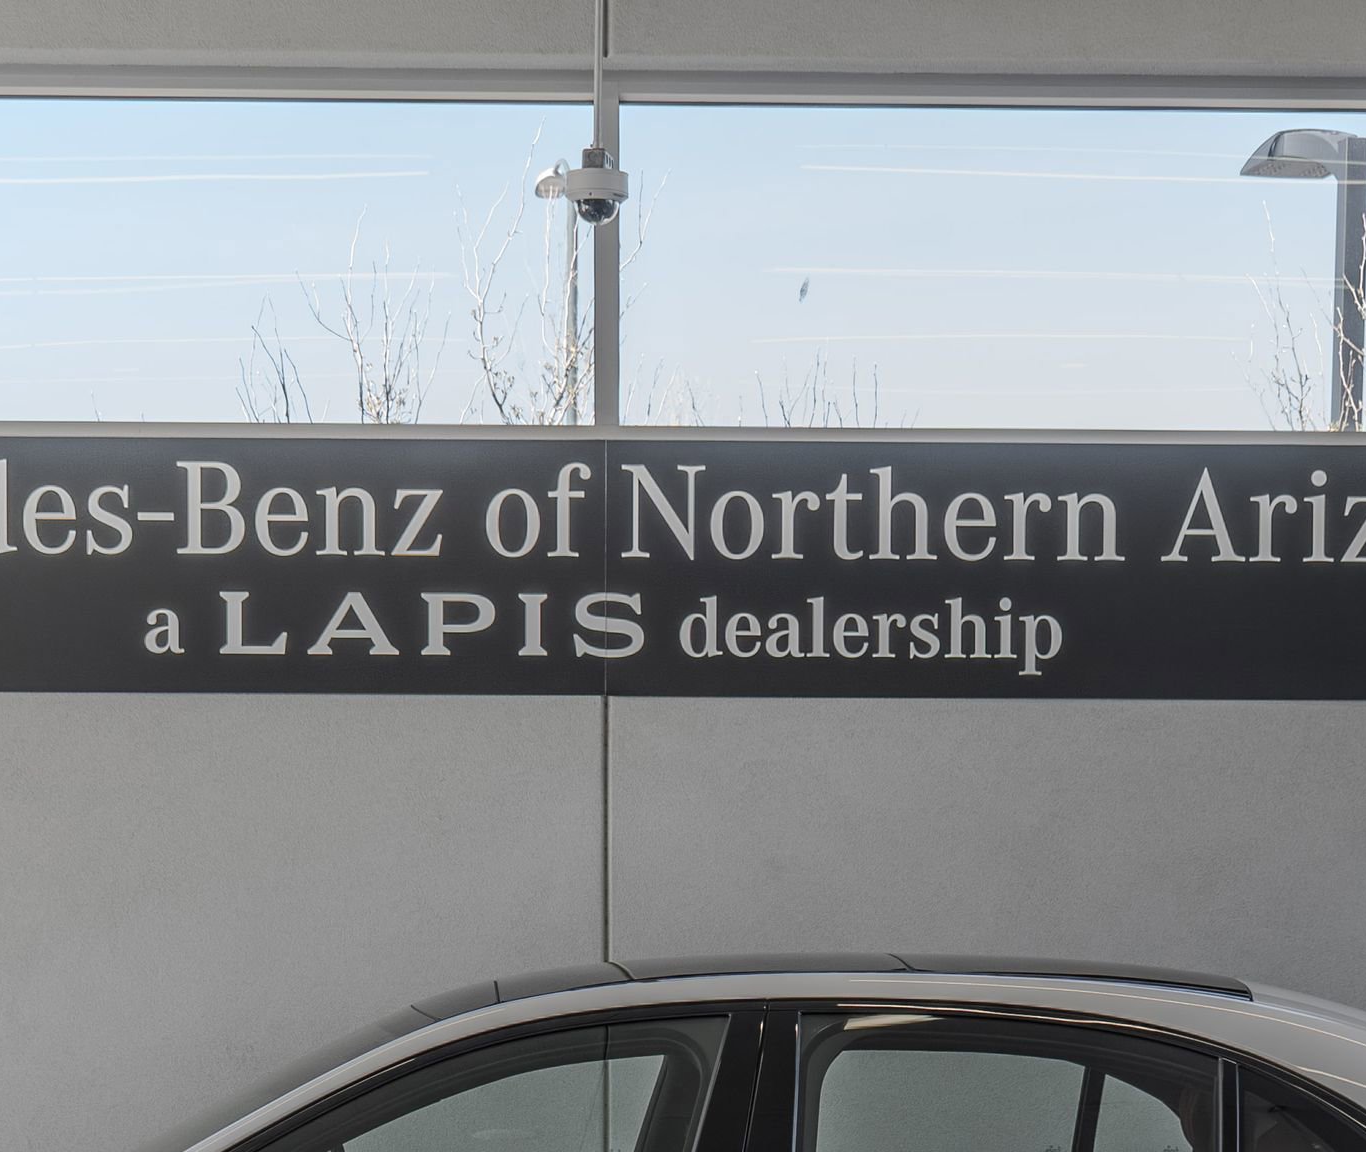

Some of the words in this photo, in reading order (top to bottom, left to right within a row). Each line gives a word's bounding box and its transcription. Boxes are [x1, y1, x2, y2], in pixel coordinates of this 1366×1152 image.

[485, 461, 592, 558] of
[619, 463, 1127, 562] Northern
[143, 608, 186, 655] a
[219, 591, 646, 658] LAPIS
[679, 595, 1064, 676] dealership
